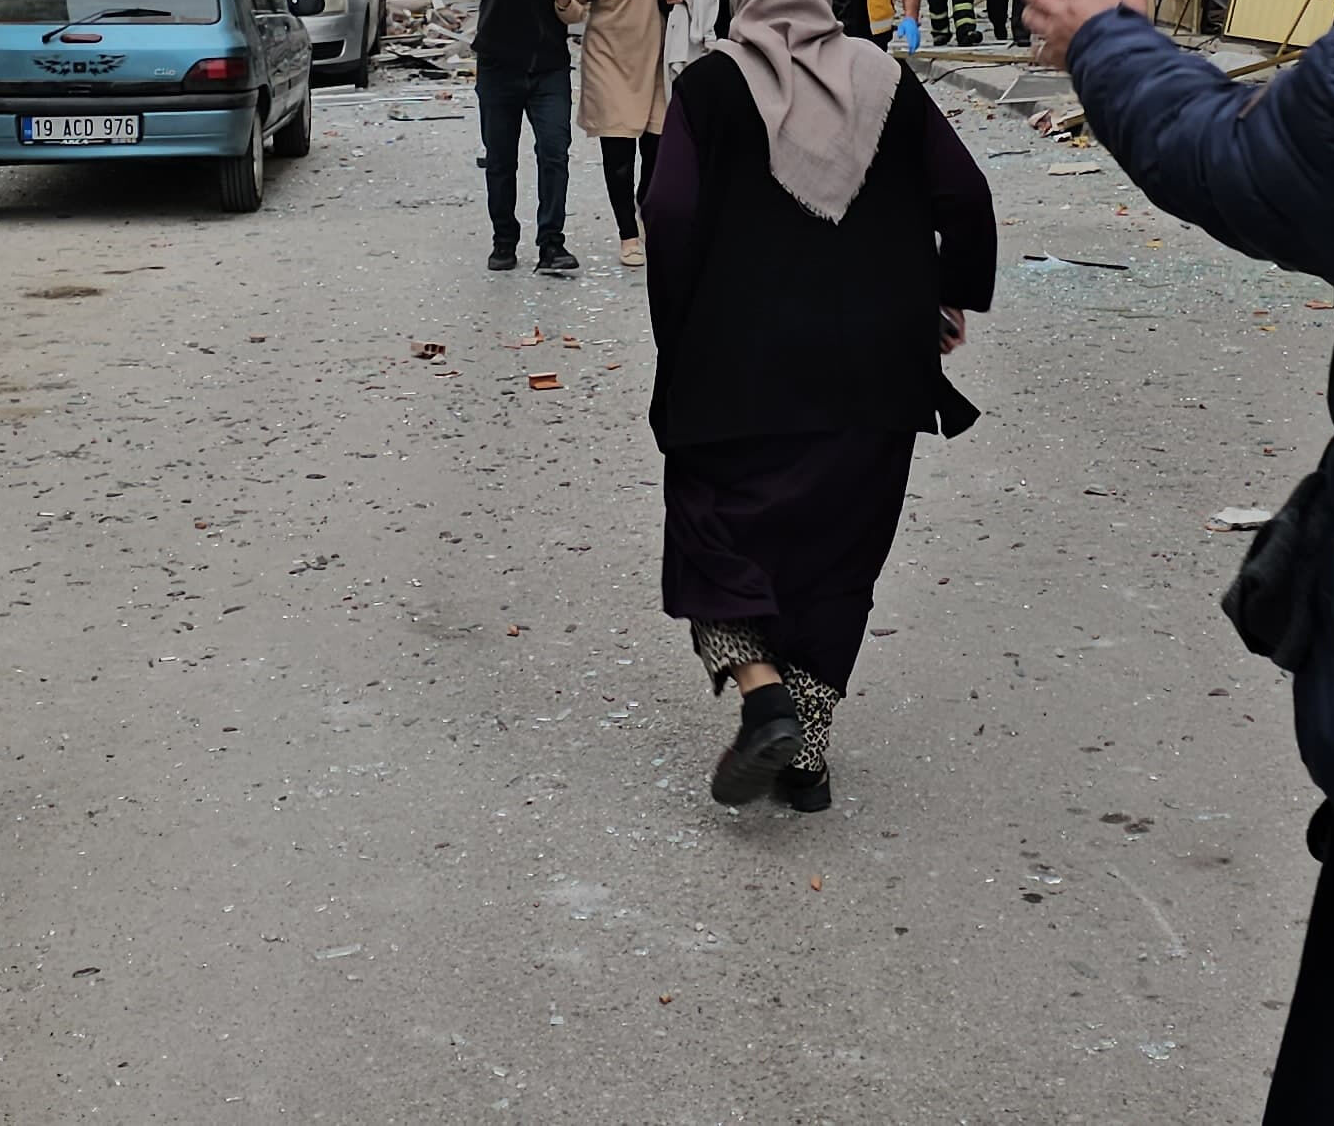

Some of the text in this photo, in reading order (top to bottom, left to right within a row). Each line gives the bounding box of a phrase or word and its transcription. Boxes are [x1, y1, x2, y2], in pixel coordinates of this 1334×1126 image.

[35, 118, 135, 137] 19 ACD 976
